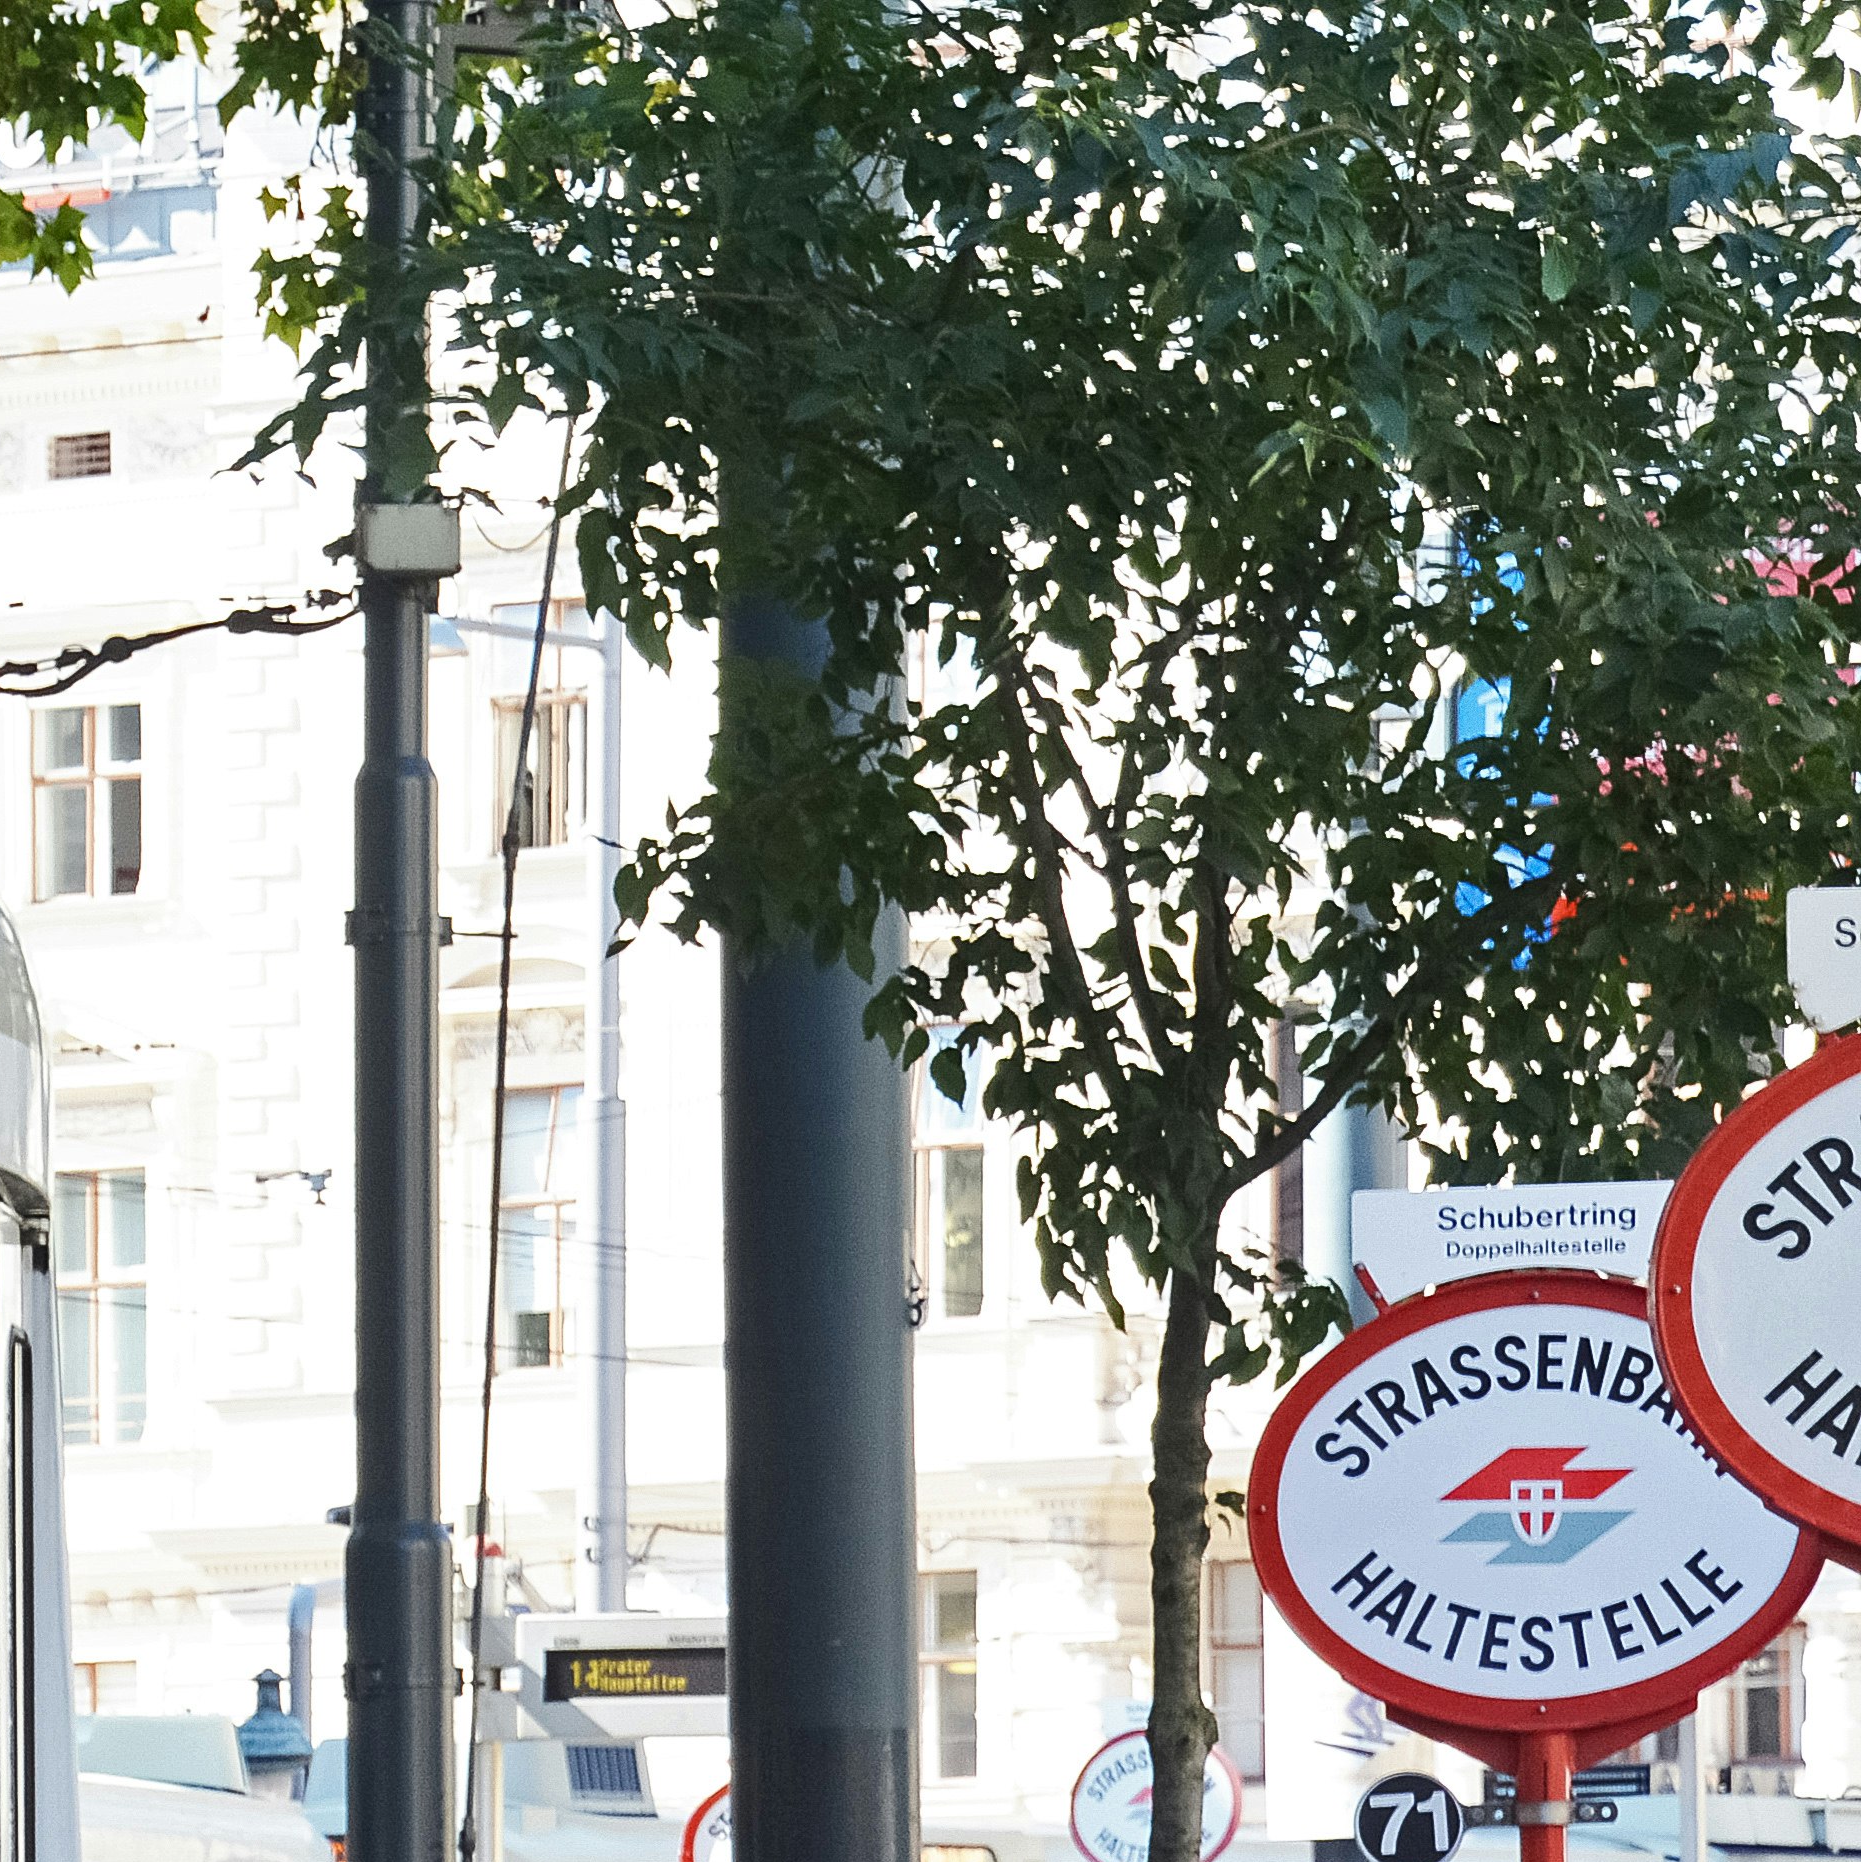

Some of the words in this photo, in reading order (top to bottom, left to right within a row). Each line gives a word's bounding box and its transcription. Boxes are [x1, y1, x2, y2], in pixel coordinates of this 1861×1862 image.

[1835, 917, 1861, 947] S
[1437, 1202, 1637, 1231] Schubertring
[1742, 1128, 1861, 1261] STR
[1445, 1237, 1627, 1262] Doppelhaltestelle
[1314, 1333, 1729, 1479] STRASSENBA
[1764, 1349, 1861, 1468] HA
[1330, 1547, 1744, 1672] HALTESTELLE
[600, 1658, 651, 1676] Prater
[600, 1675, 688, 1693] Hauptallee
[1368, 1790, 1450, 1857] 71
